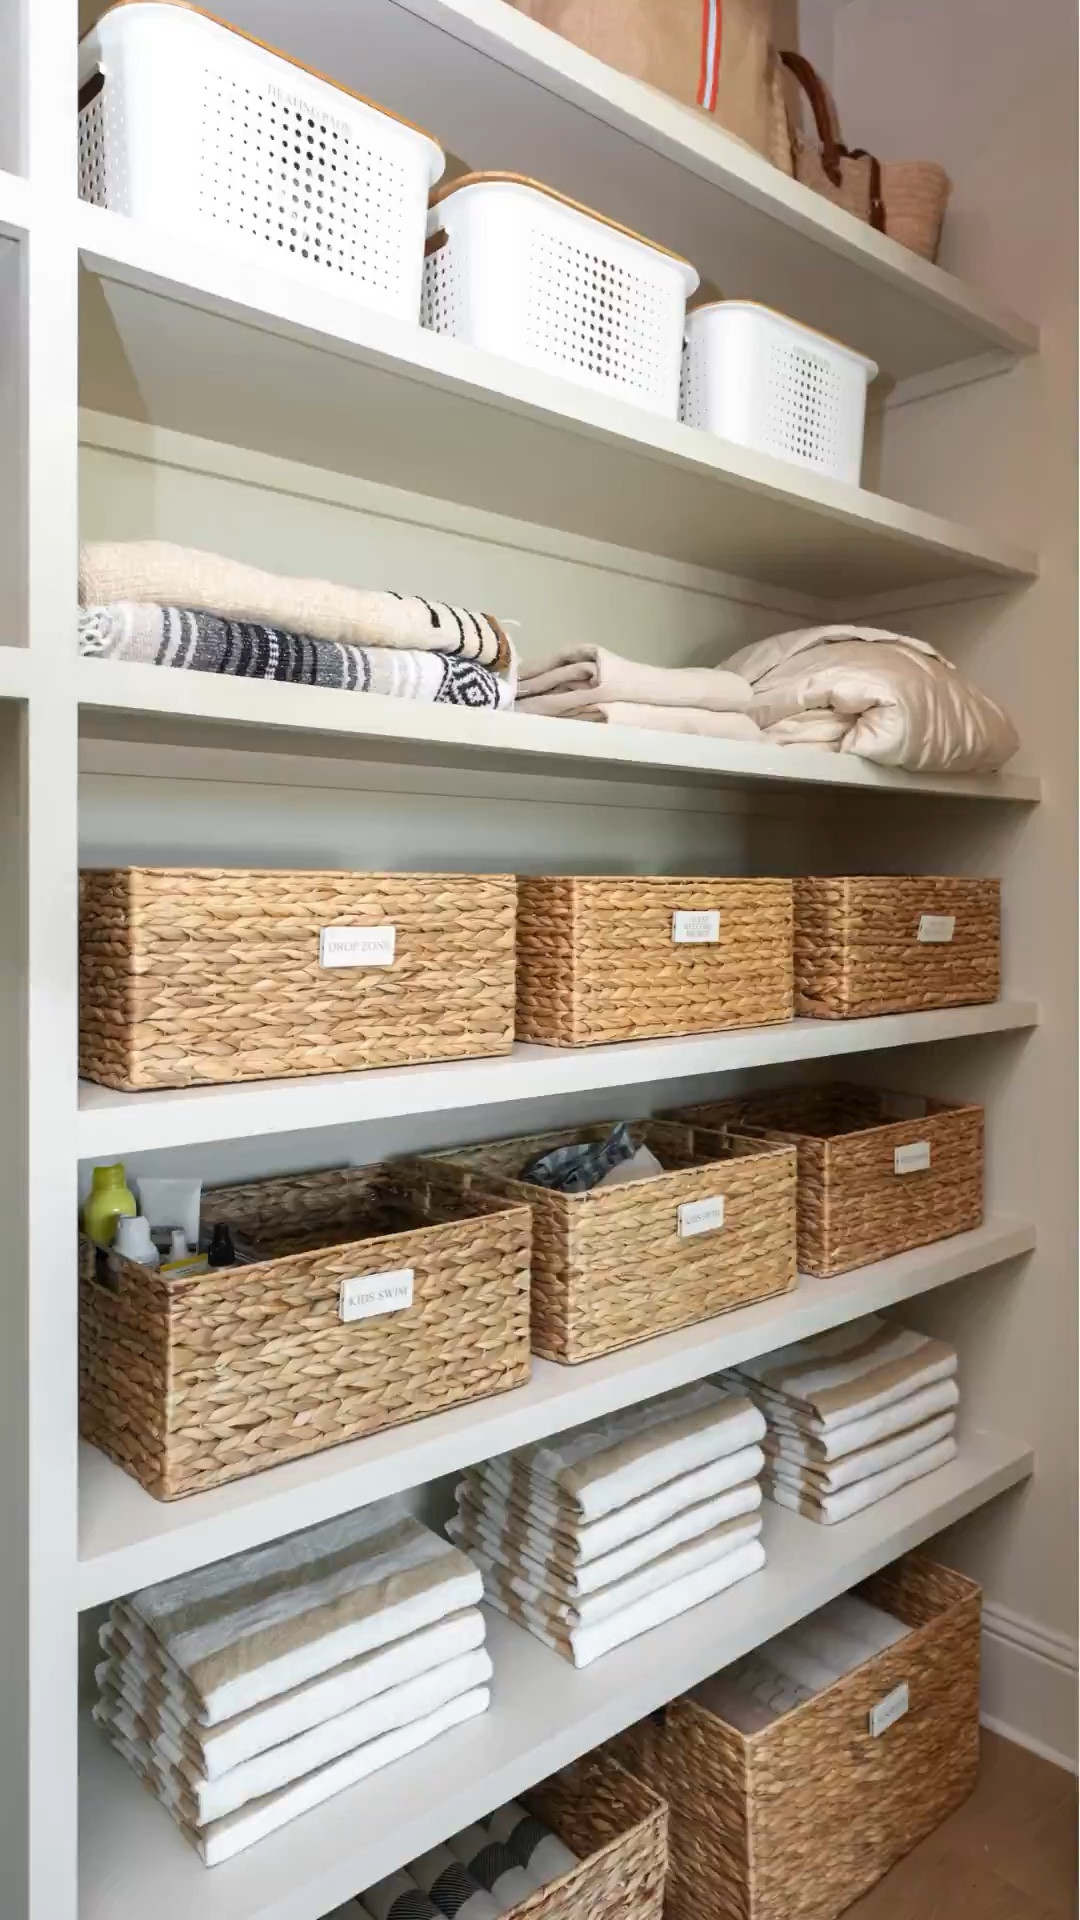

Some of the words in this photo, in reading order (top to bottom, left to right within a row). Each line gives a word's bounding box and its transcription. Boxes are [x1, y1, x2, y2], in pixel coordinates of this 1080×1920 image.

[328, 940, 358, 953] DROP
[348, 1290, 375, 1306] KIDS
[378, 1286, 408, 1300] SWIM
